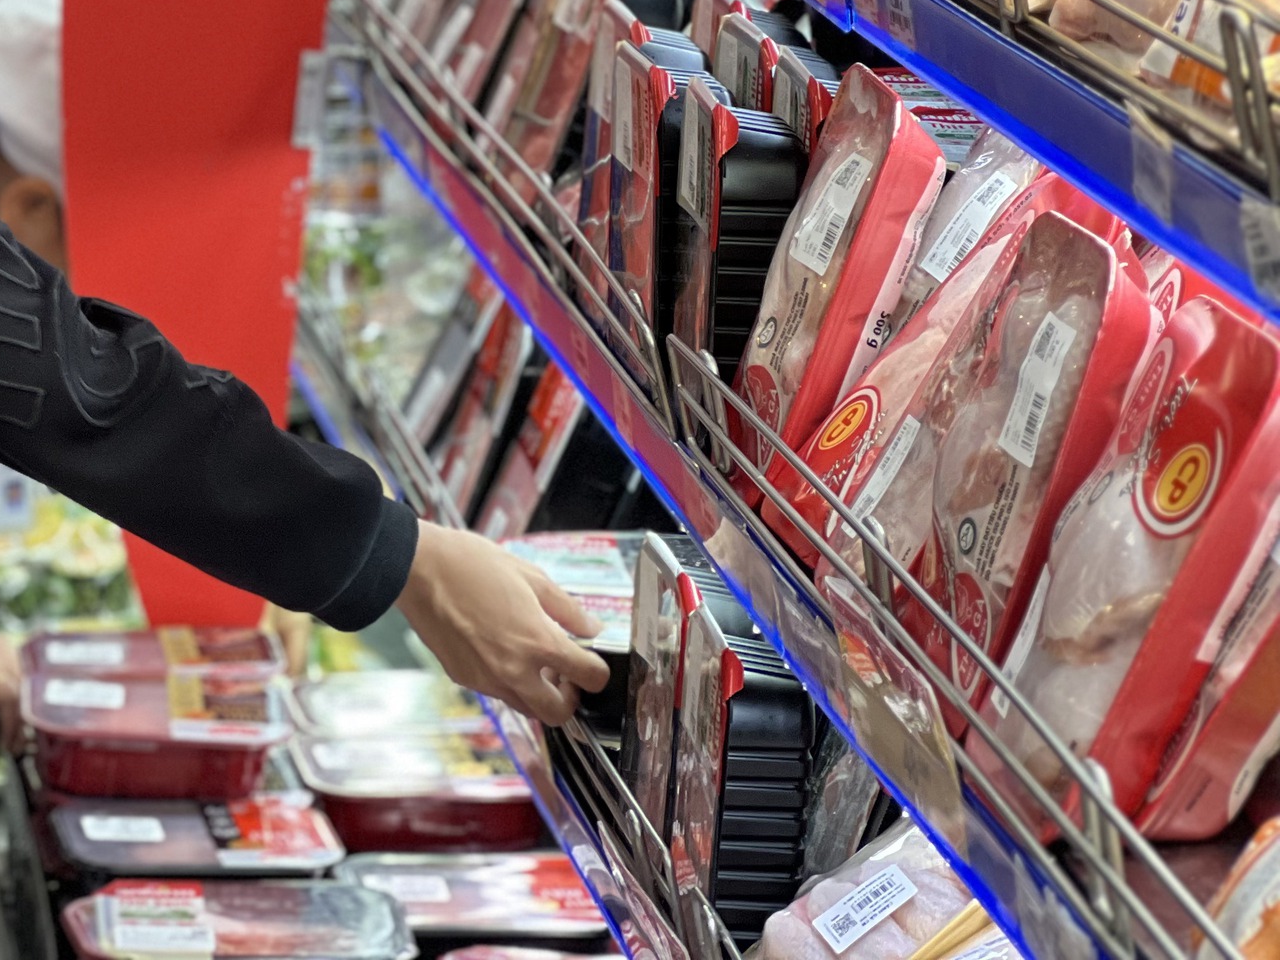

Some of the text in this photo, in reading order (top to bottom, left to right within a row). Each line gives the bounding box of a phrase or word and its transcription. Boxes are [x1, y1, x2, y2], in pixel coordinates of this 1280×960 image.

[866, 311, 891, 349] 500 g
[825, 407, 859, 443] CP
[1167, 455, 1200, 504] CP
